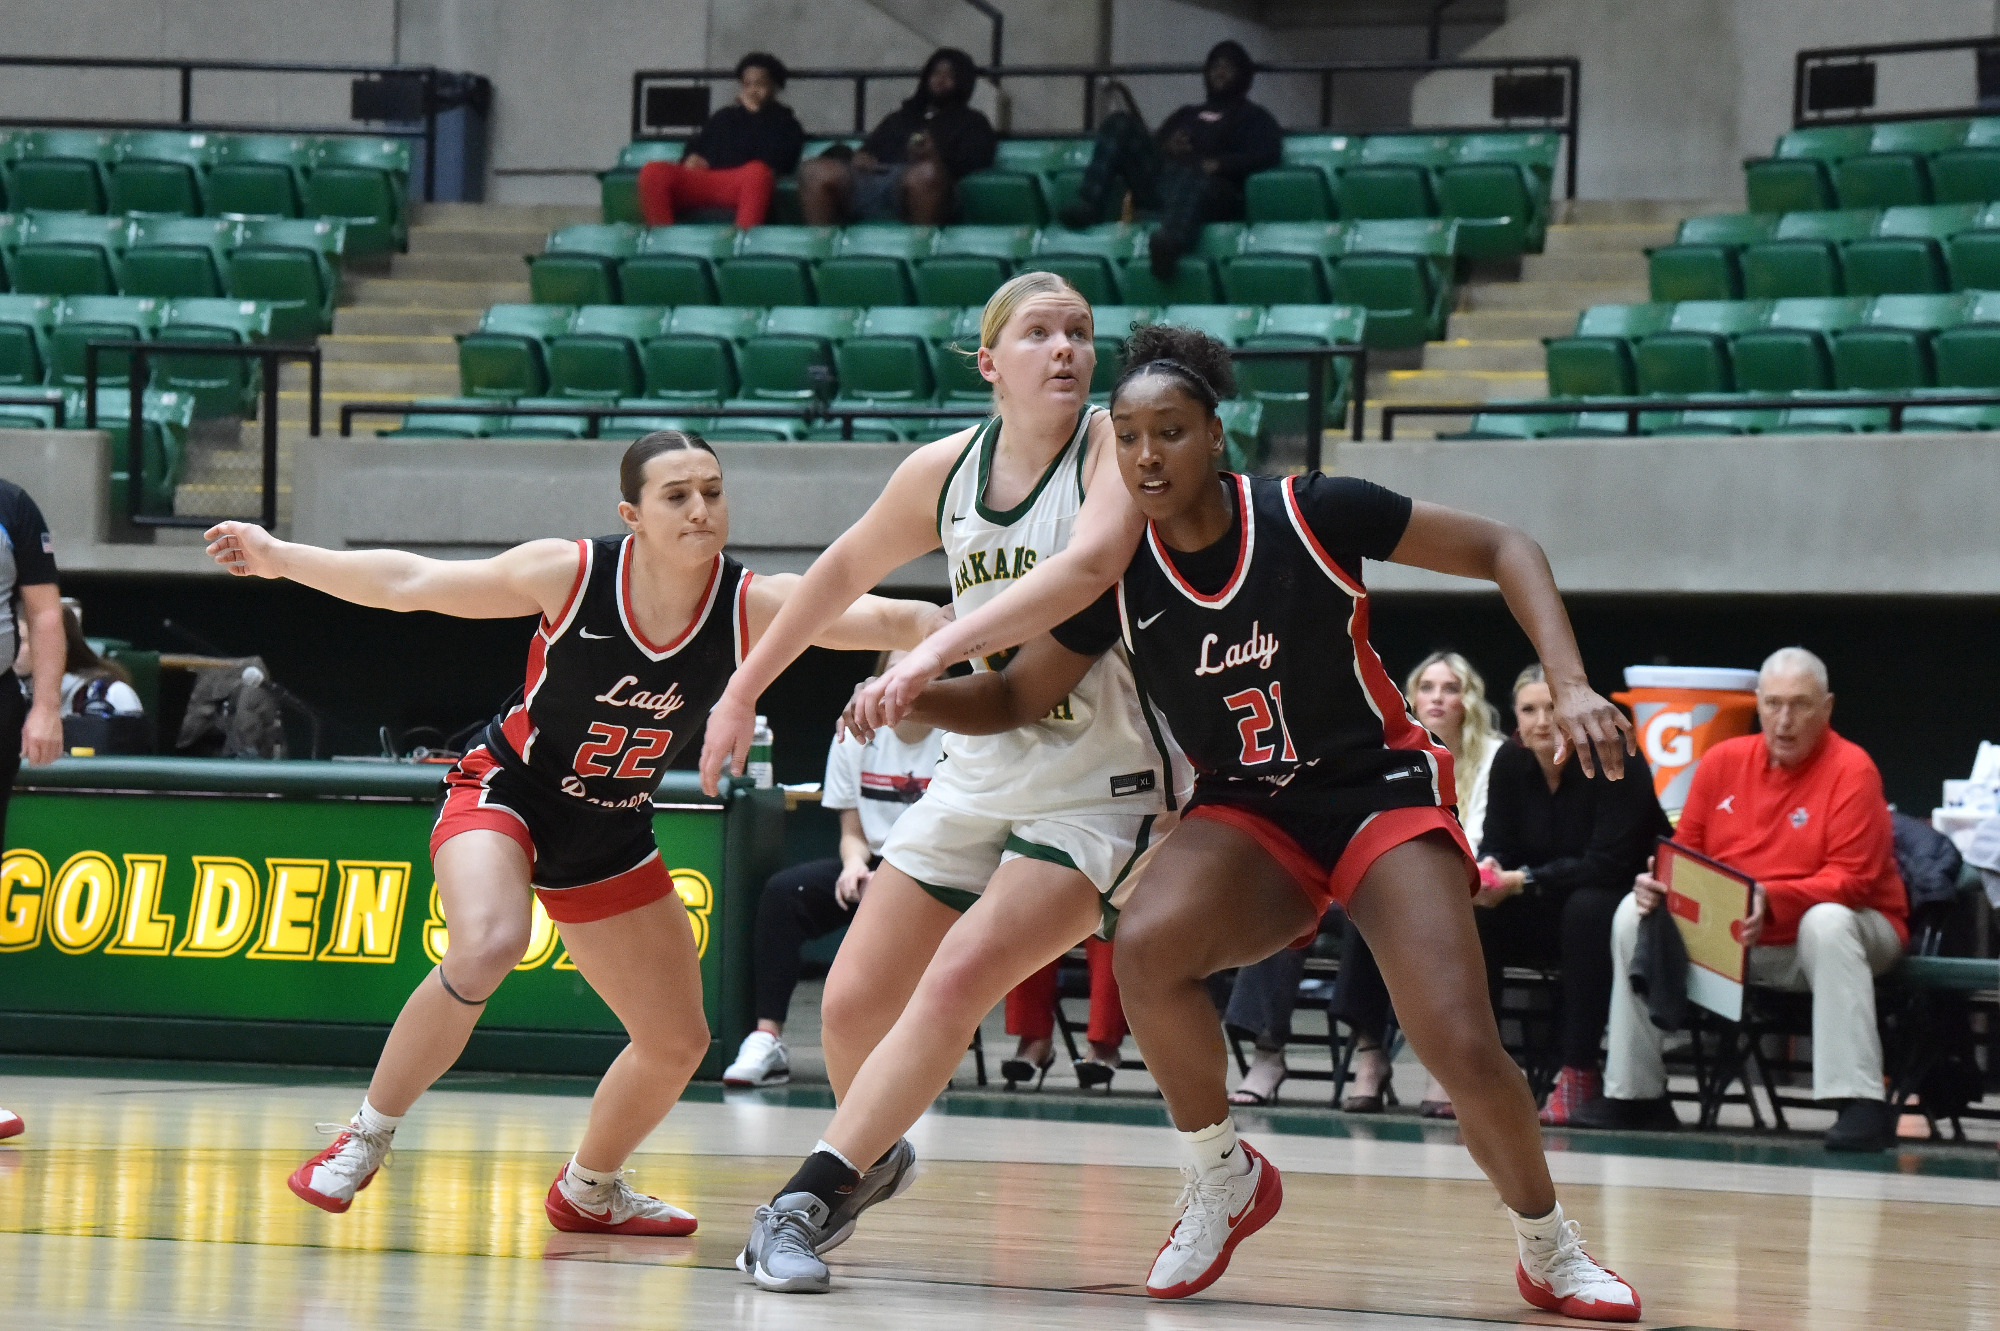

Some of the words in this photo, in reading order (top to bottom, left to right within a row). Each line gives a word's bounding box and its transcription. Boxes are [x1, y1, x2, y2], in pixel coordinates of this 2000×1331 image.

[1194, 620, 1279, 676] Lady
[595, 675, 684, 720] Lady
[1223, 680, 1298, 766] 21
[573, 721, 673, 779] 22
[1645, 711, 1694, 768] G
[1140, 777, 1151, 786] XL
[0, 848, 412, 964] GOLDEN
